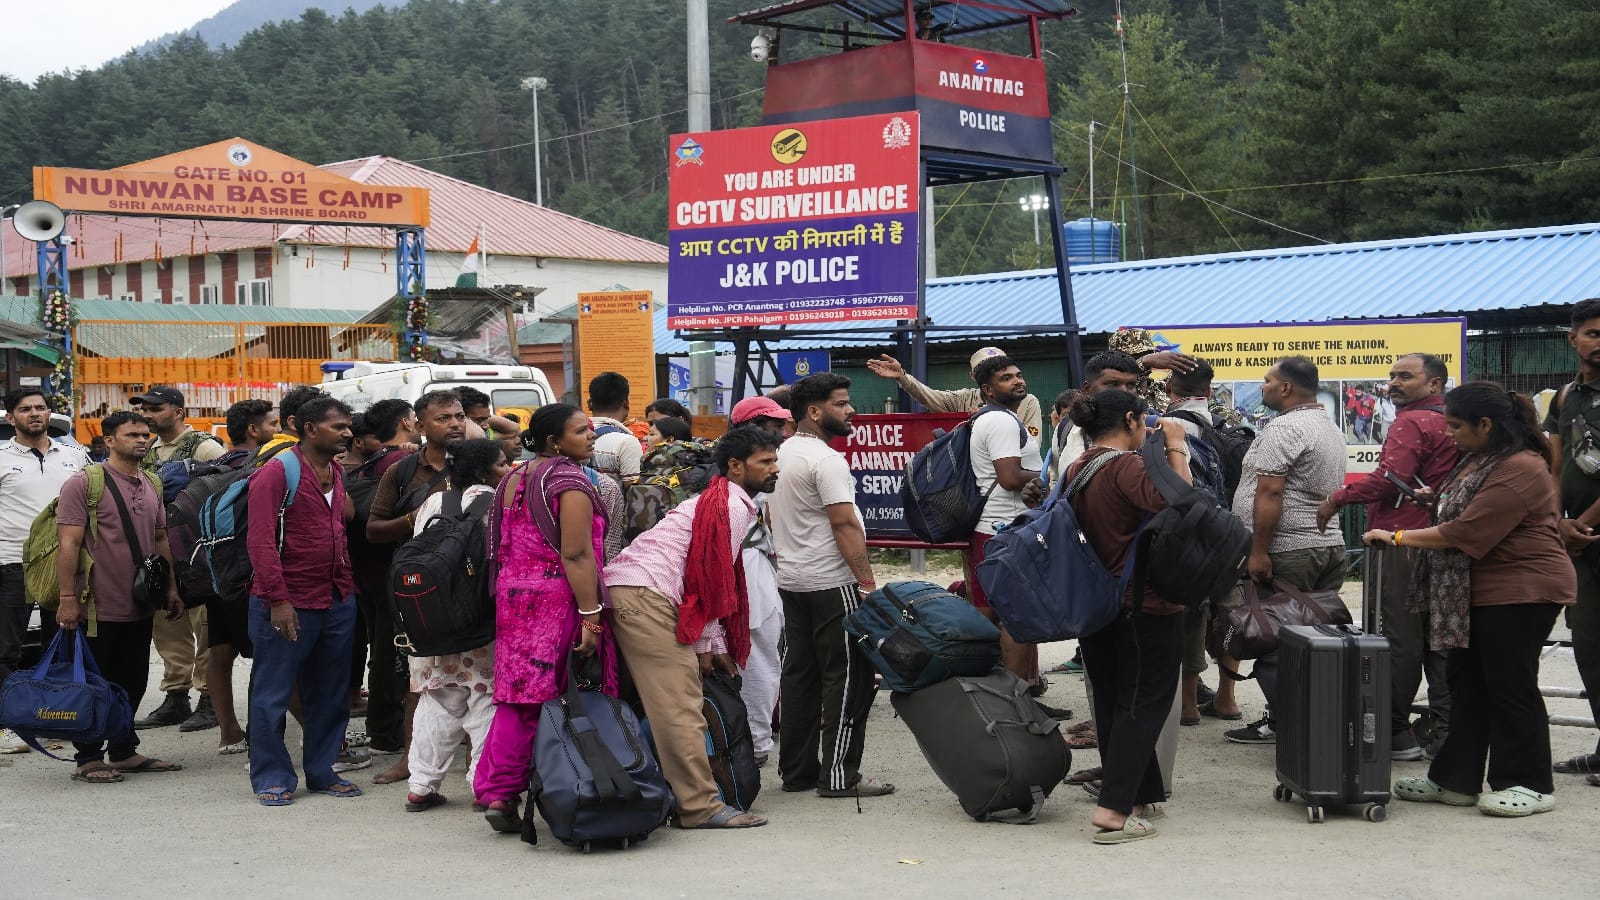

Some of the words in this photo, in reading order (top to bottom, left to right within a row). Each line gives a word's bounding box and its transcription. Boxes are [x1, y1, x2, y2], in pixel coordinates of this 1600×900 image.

[975, 59, 985, 70] 2
[938, 70, 1024, 97] ANANTNAG
[959, 109, 1006, 133] POLICE
[174, 165, 231, 181] GATE
[238, 169, 274, 184] NO.
[281, 171, 306, 185] 01
[724, 171, 758, 192] YOU
[761, 169, 794, 189] ARE
[797, 163, 856, 187] UNDER
[65, 176, 215, 202] NUNWAN
[226, 185, 309, 206] BASE
[318, 189, 404, 210] CAMP
[108, 199, 146, 210] SHRI
[151, 202, 237, 214] AMARNATH
[241, 206, 255, 215] JI
[259, 207, 315, 218] SHRINE
[318, 209, 368, 220] BOARD
[676, 198, 737, 226] CCTV
[740, 184, 909, 222] SURVEILLANCE
[679, 240, 713, 257] आप
[717, 236, 769, 255] CCTV
[772, 229, 799, 251] की
[802, 223, 867, 250] निगरानी
[870, 222, 885, 245] में
[719, 261, 769, 288] J&K
[775, 255, 859, 286] POLICE
[678, 305, 711, 315] Helpline
[712, 303, 726, 312] No.
[728, 303, 744, 311] PCR
[745, 301, 784, 311] Anantnag
[789, 298, 846, 309] 01932223748
[852, 295, 904, 305] 9596777669
[674, 318, 706, 327] Helpline
[708, 316, 722, 325] No.
[723, 315, 743, 325] JPCR
[745, 313, 783, 324] Pahalgam
[789, 310, 845, 321] 01936243018
[851, 307, 909, 318] 01936243233
[1193, 342, 1233, 353] ALWAYS
[1236, 342, 1269, 352] READY
[1272, 341, 1285, 351] TO
[1288, 340, 1321, 351] SERVE
[1324, 340, 1343, 350] THE
[1346, 339, 1389, 350] NATION.
[1235, 358, 1243, 367] &
[1336, 356, 1347, 365] IS
[1350, 355, 1393, 365] ALWAYS
[847, 424, 904, 447] POLICE
[851, 452, 915, 470] ANANTN
[1349, 451, 1382, 463] -202
[862, 475, 905, 494] SERV
[36, 706, 77, 720] Adventure
